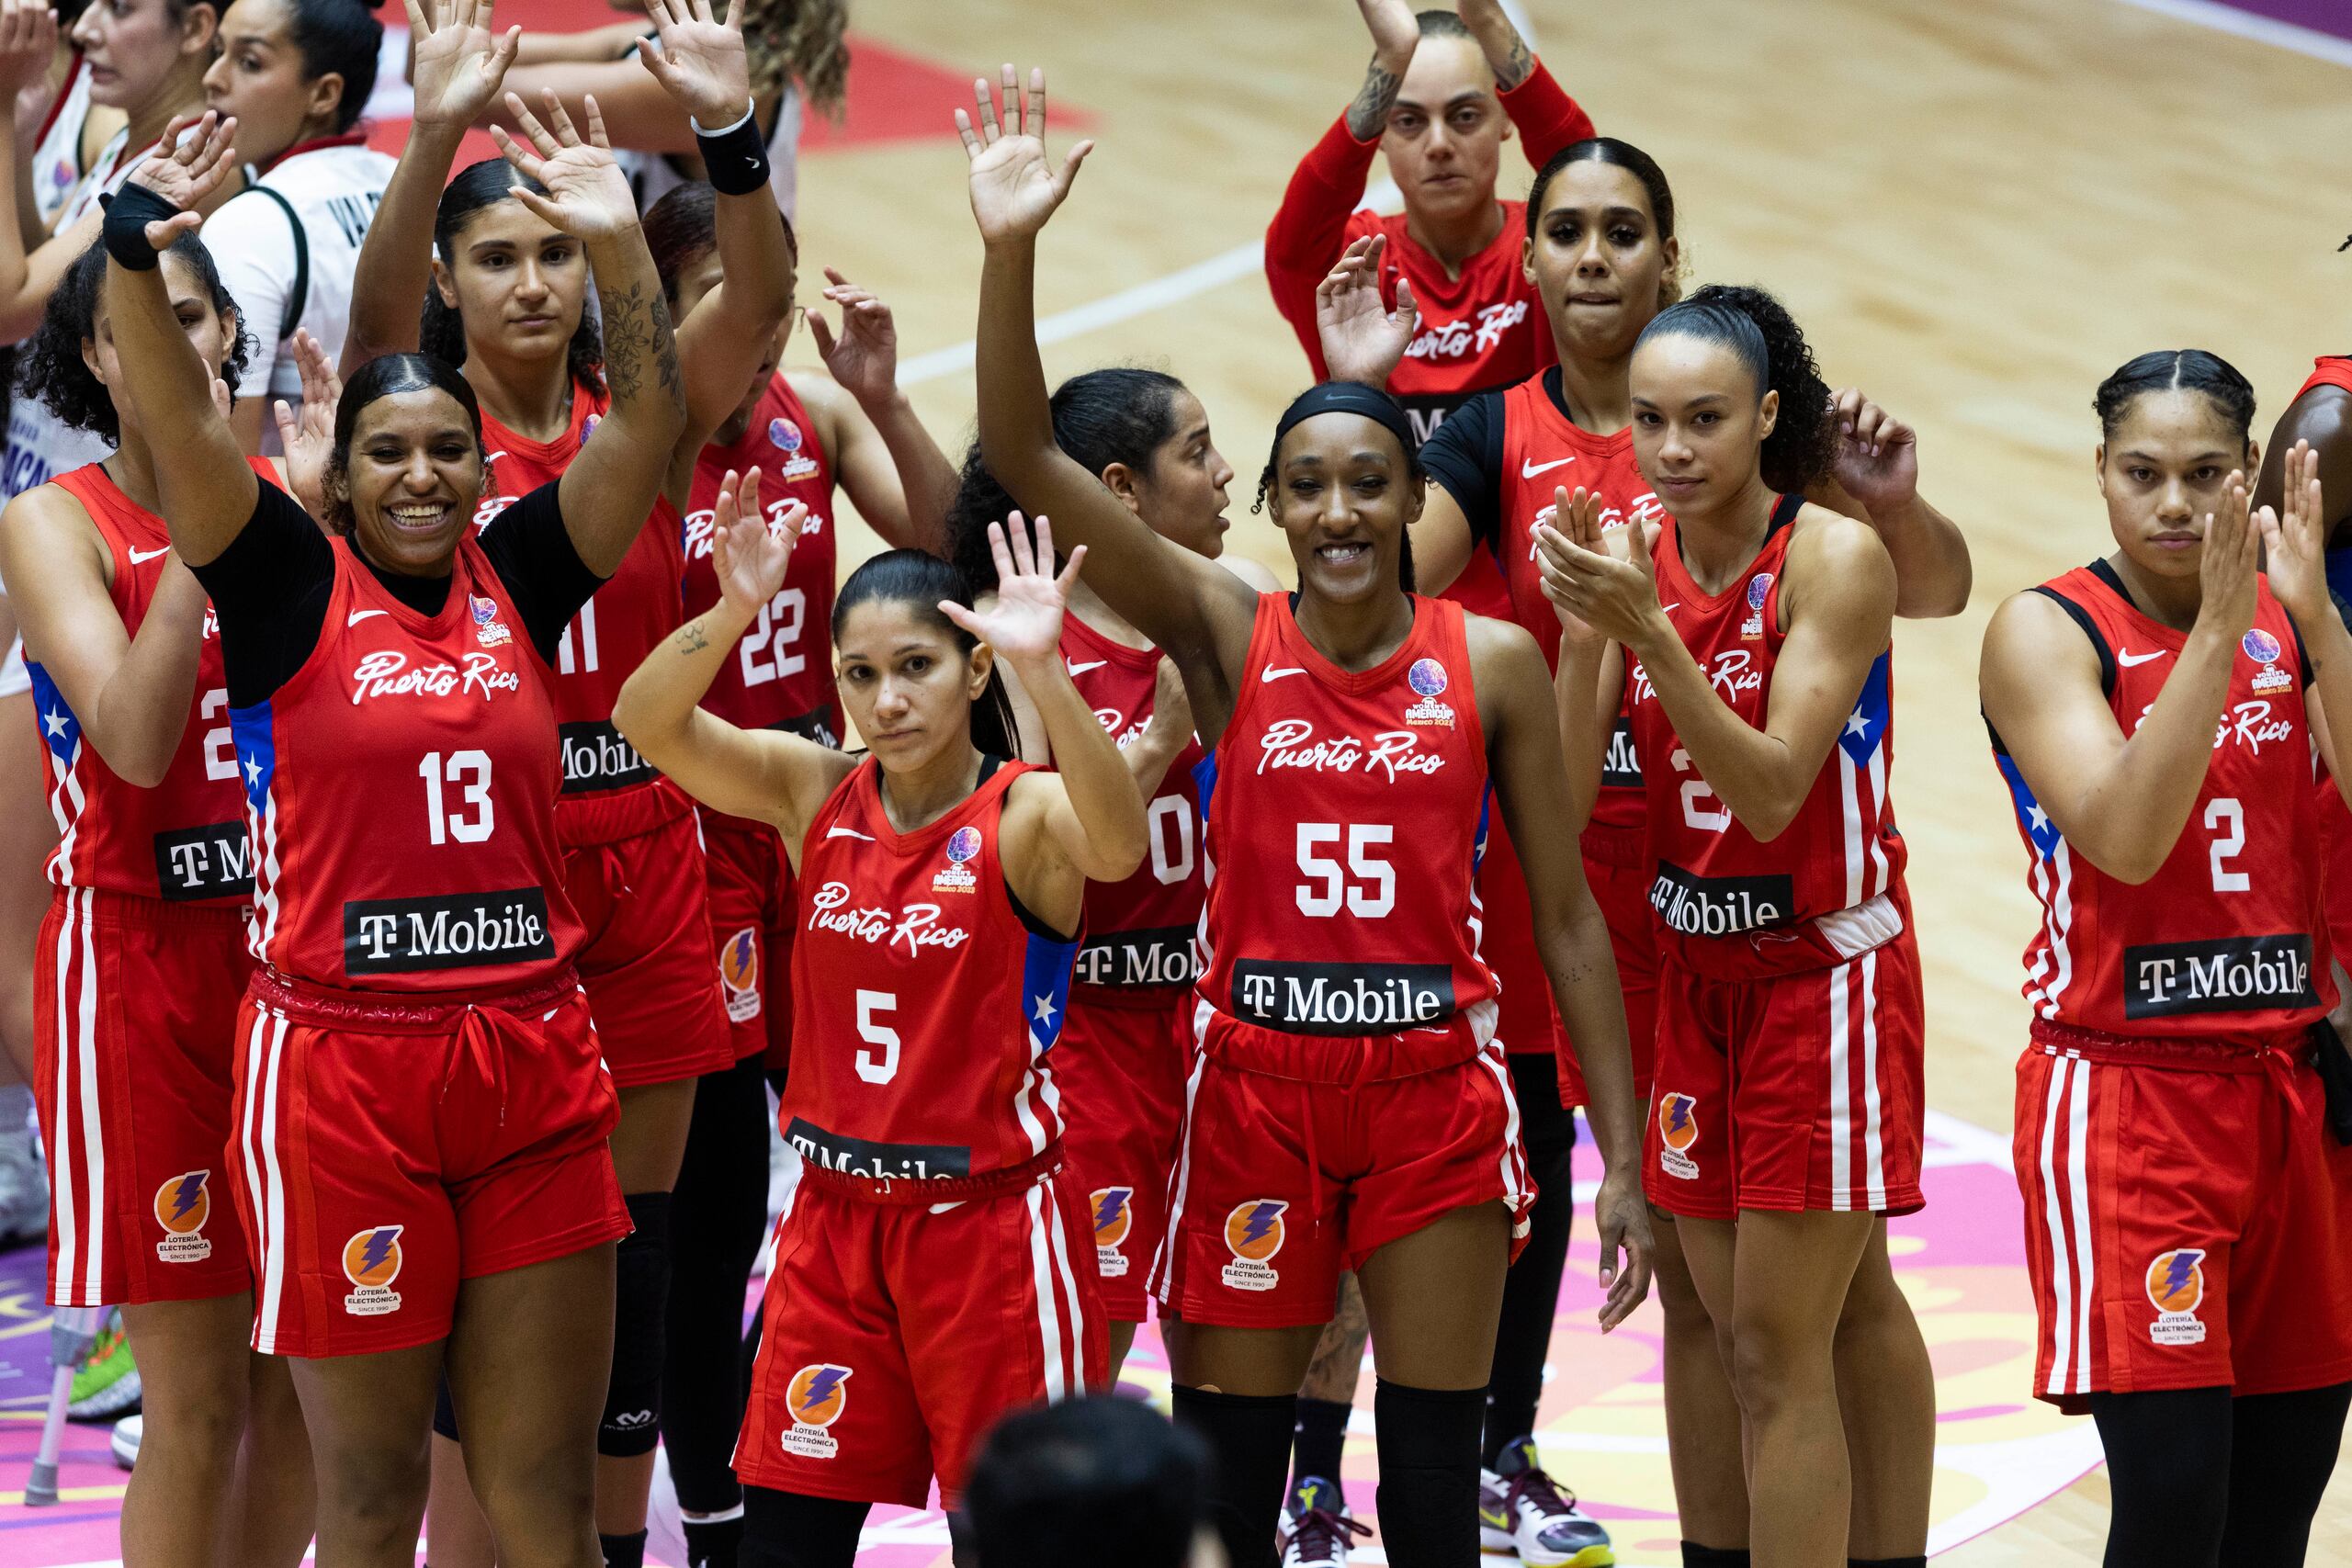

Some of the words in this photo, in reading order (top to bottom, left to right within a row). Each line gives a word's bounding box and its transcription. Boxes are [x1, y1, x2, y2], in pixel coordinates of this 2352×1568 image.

[352, 650, 459, 705] Puerto
[462, 651, 520, 702] Rico
[1256, 719, 1363, 776] Puerto
[1364, 731, 1446, 784] Rico
[2233, 700, 2293, 756] Rico
[419, 749, 495, 846] 13
[2204, 797, 2251, 892] 2
[1295, 822, 1396, 919] 55
[359, 914, 398, 960] T
[406, 903, 545, 957] Mobile
[808, 881, 891, 943] Puerto
[889, 903, 969, 959] Rico
[1666, 882, 1781, 935] Mobile
[1243, 975, 1275, 1019] T
[1283, 977, 1441, 1024] Mobile
[2139, 958, 2177, 1003] T
[2185, 949, 2308, 998] Mobile
[854, 988, 901, 1086] 5
[159, 1242, 209, 1251] ELECTRÓNICA
[168, 1235, 198, 1243] LOTERÍA
[1225, 1268, 1276, 1280] ELECTRÓNICA
[1235, 1261, 1266, 1271] LOTERÍA
[347, 1294, 399, 1304] ELECTRÓNICA
[356, 1288, 388, 1296] LOTERÍA
[2153, 1324, 2203, 1333] ELECTRÓNICA
[784, 1433, 835, 1448] ELECTRÓNICA
[793, 1445, 809, 1453] SINCE
[794, 1427, 825, 1438] LOTERÍA
